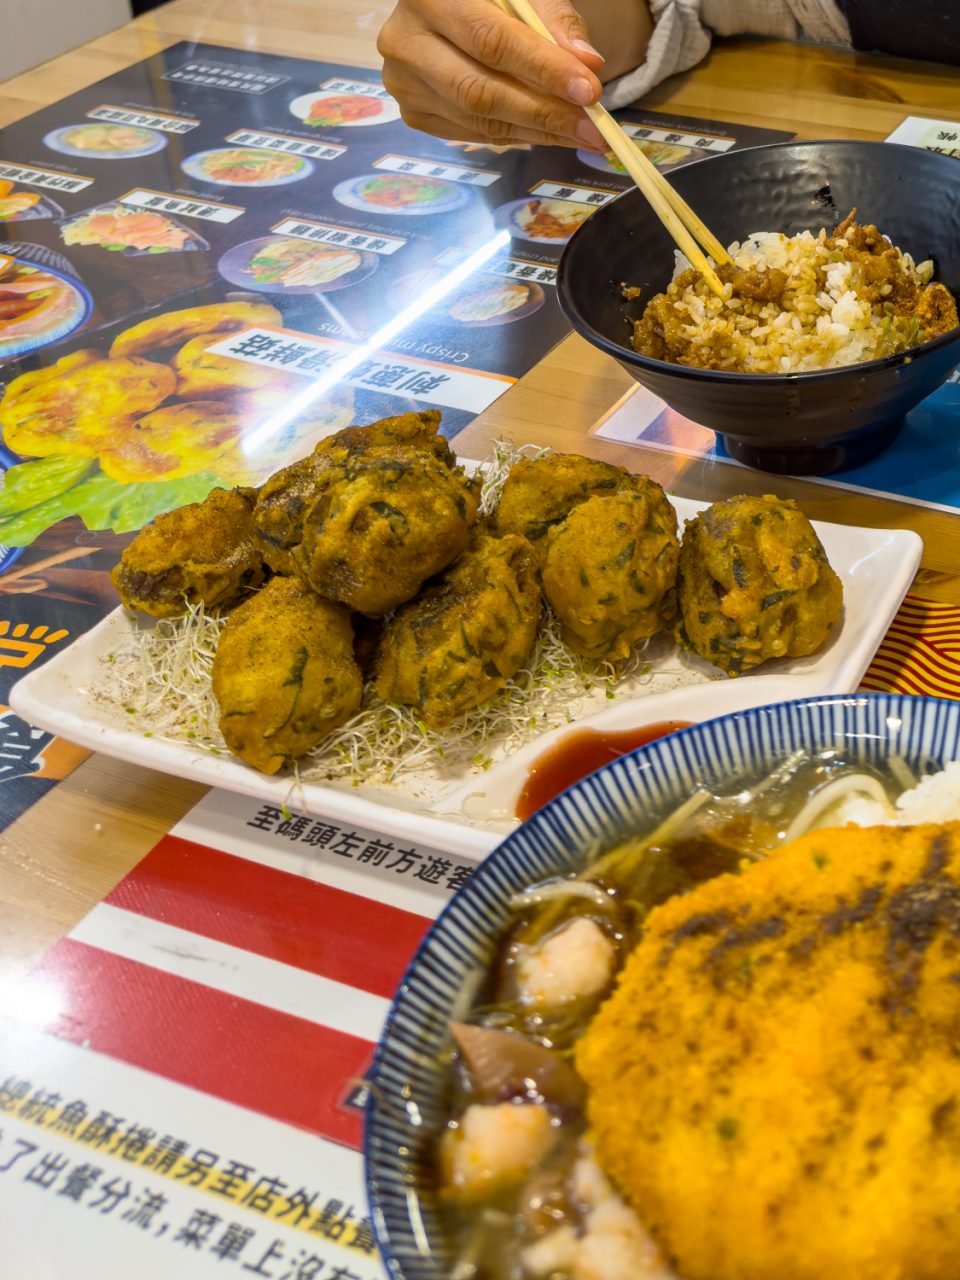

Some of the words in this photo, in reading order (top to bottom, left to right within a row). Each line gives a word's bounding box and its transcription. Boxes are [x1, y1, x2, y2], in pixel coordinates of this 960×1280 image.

[420, 341, 470, 364] Crispy
[246, 804, 478, 891] 至碼頭左前方遊客
